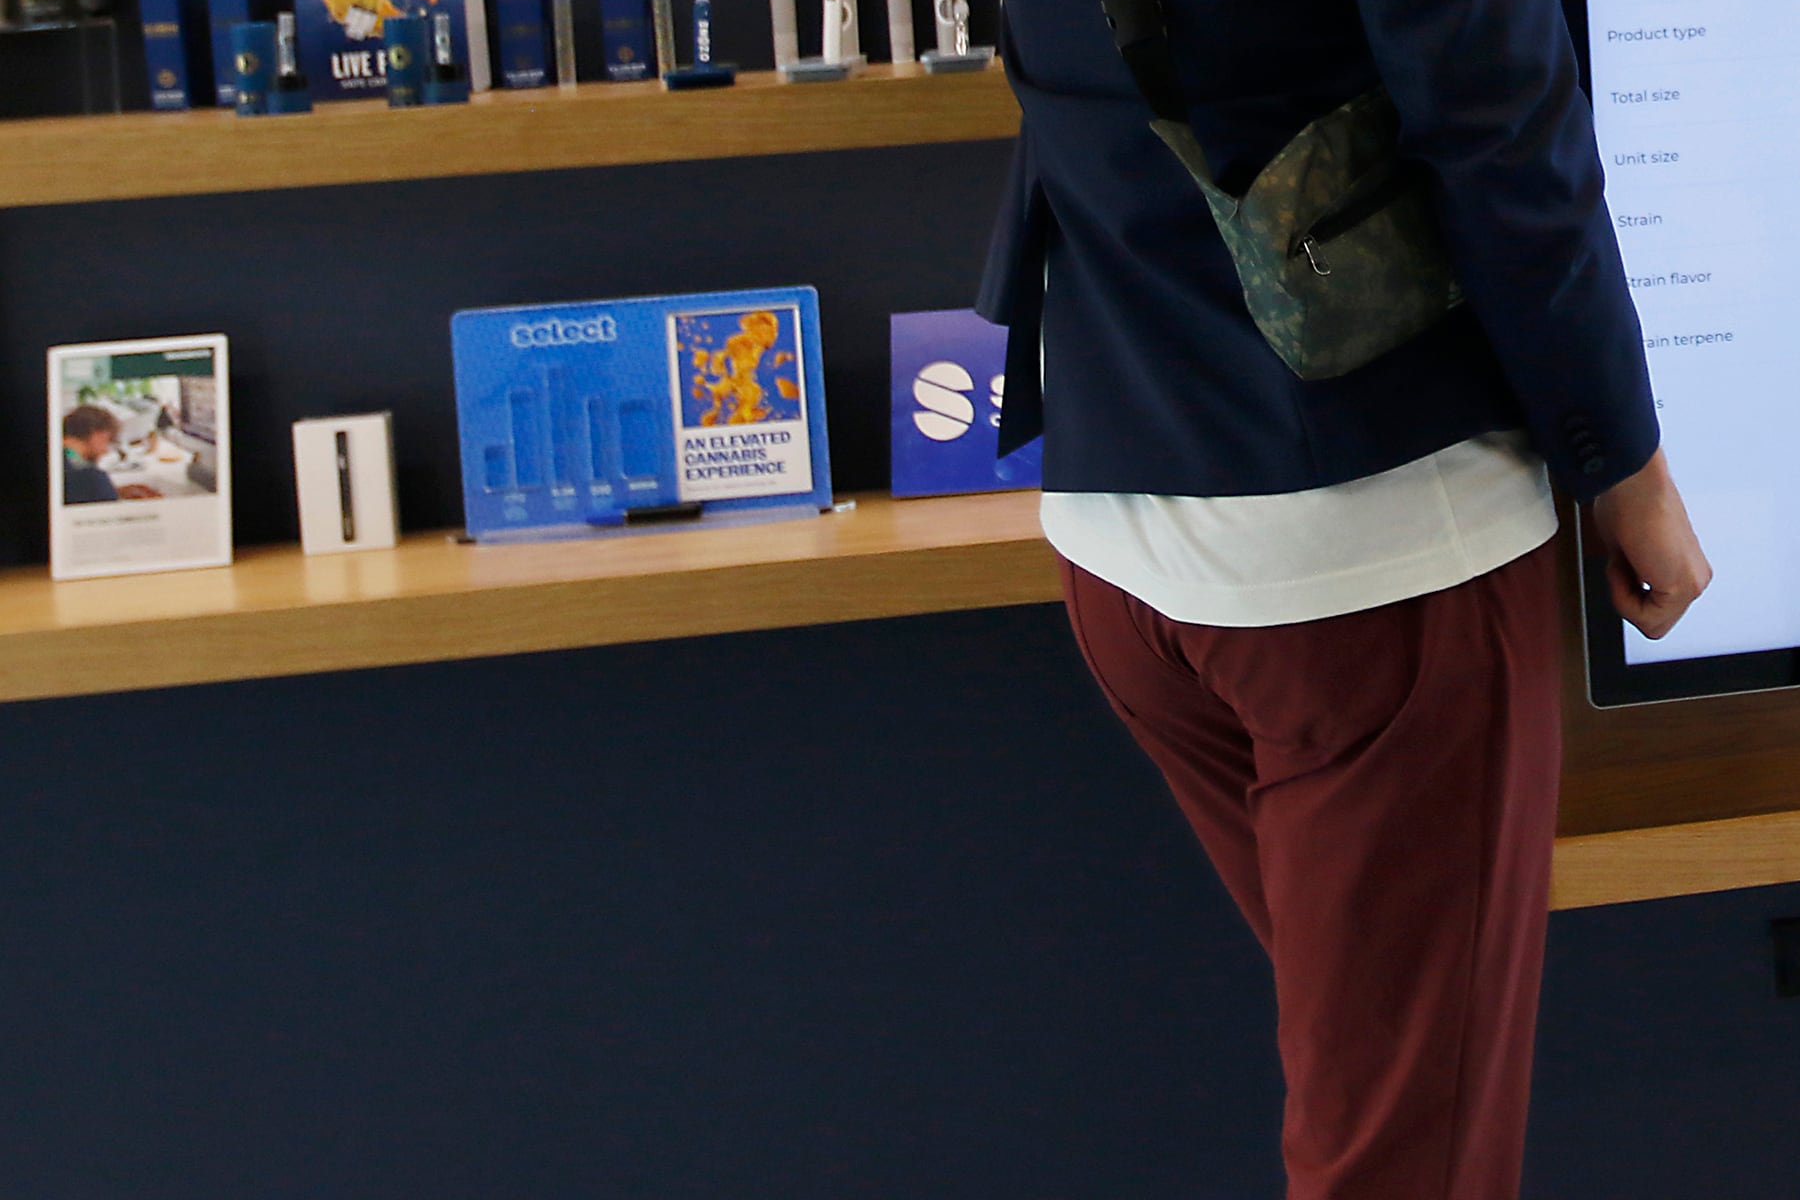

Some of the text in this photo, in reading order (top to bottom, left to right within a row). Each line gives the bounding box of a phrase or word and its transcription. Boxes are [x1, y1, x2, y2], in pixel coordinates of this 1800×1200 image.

[1607, 25, 1706, 43] Product type
[331, 51, 372, 79] LIVE
[1611, 89, 1681, 105] Total size
[1614, 150, 1680, 167] Unit size
[1618, 213, 1663, 228] Strain
[1670, 270, 1712, 286] flavor
[511, 315, 617, 348] select
[1673, 330, 1734, 348] terpene
[684, 431, 791, 451] AN ELEVATED
[684, 448, 768, 464] CANNABIS
[686, 462, 786, 481] EXPERIENCE
